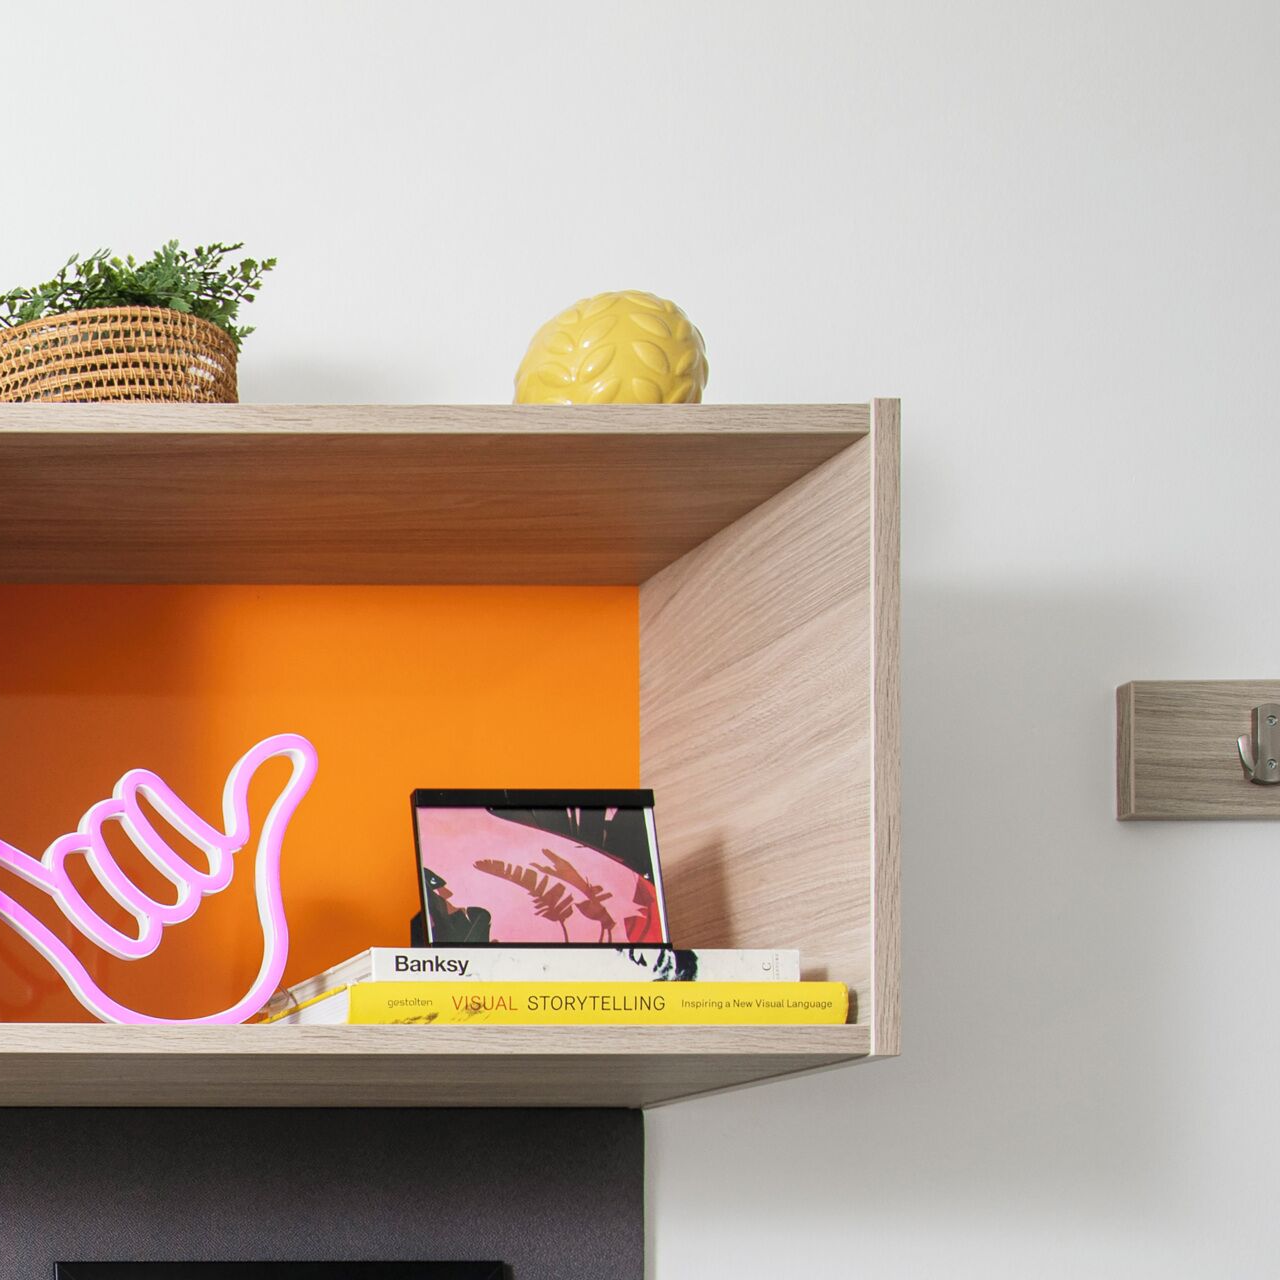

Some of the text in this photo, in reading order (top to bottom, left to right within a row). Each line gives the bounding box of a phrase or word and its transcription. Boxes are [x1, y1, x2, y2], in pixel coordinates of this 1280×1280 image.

[394, 955, 469, 976] Banksy
[387, 998, 433, 1009] gestalten
[452, 995, 666, 1011] VISUAL STORYTELLING
[681, 999, 723, 1009] Inspiring
[733, 999, 752, 1008] New
[754, 999, 785, 1008] Visual
[786, 999, 833, 1010] Language
